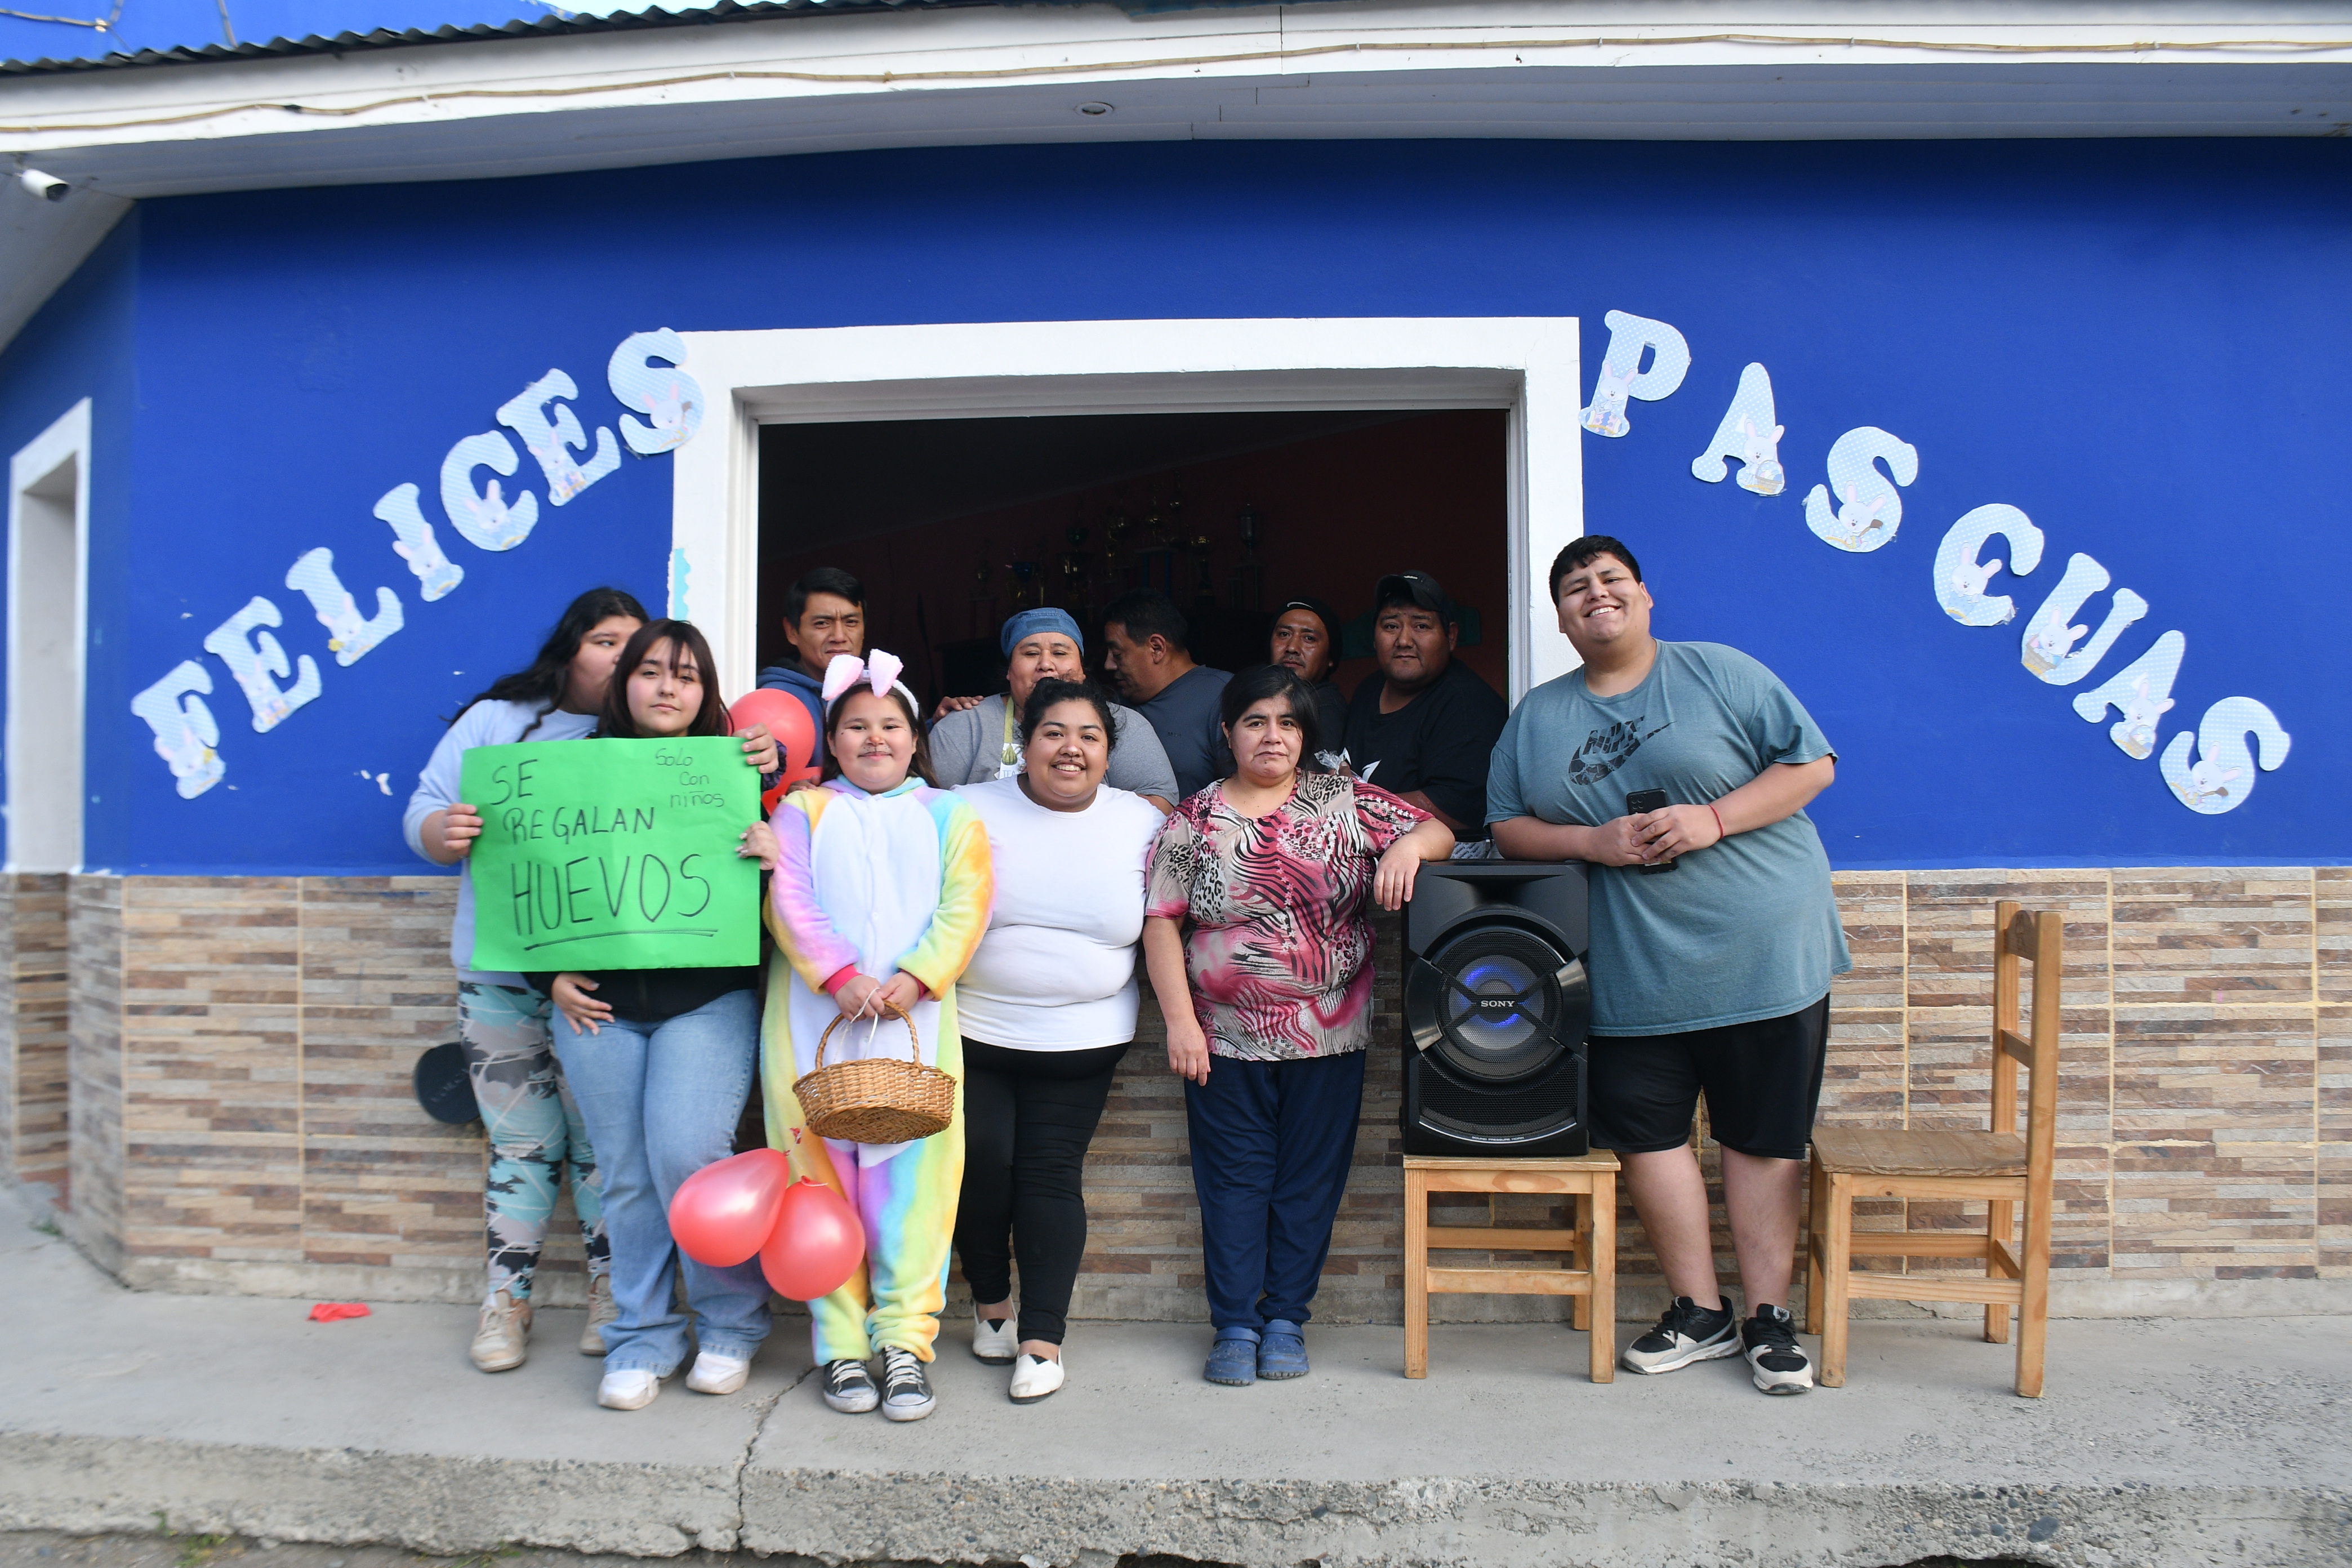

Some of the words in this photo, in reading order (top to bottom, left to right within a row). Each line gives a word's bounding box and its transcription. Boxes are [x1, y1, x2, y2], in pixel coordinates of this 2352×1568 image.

[131, 327, 704, 800] FELICES
[1579, 309, 2291, 815] PASCUAS
[489, 759, 539, 805] SE
[503, 807, 655, 845] REGALAN
[511, 854, 711, 936] HUEVOS
